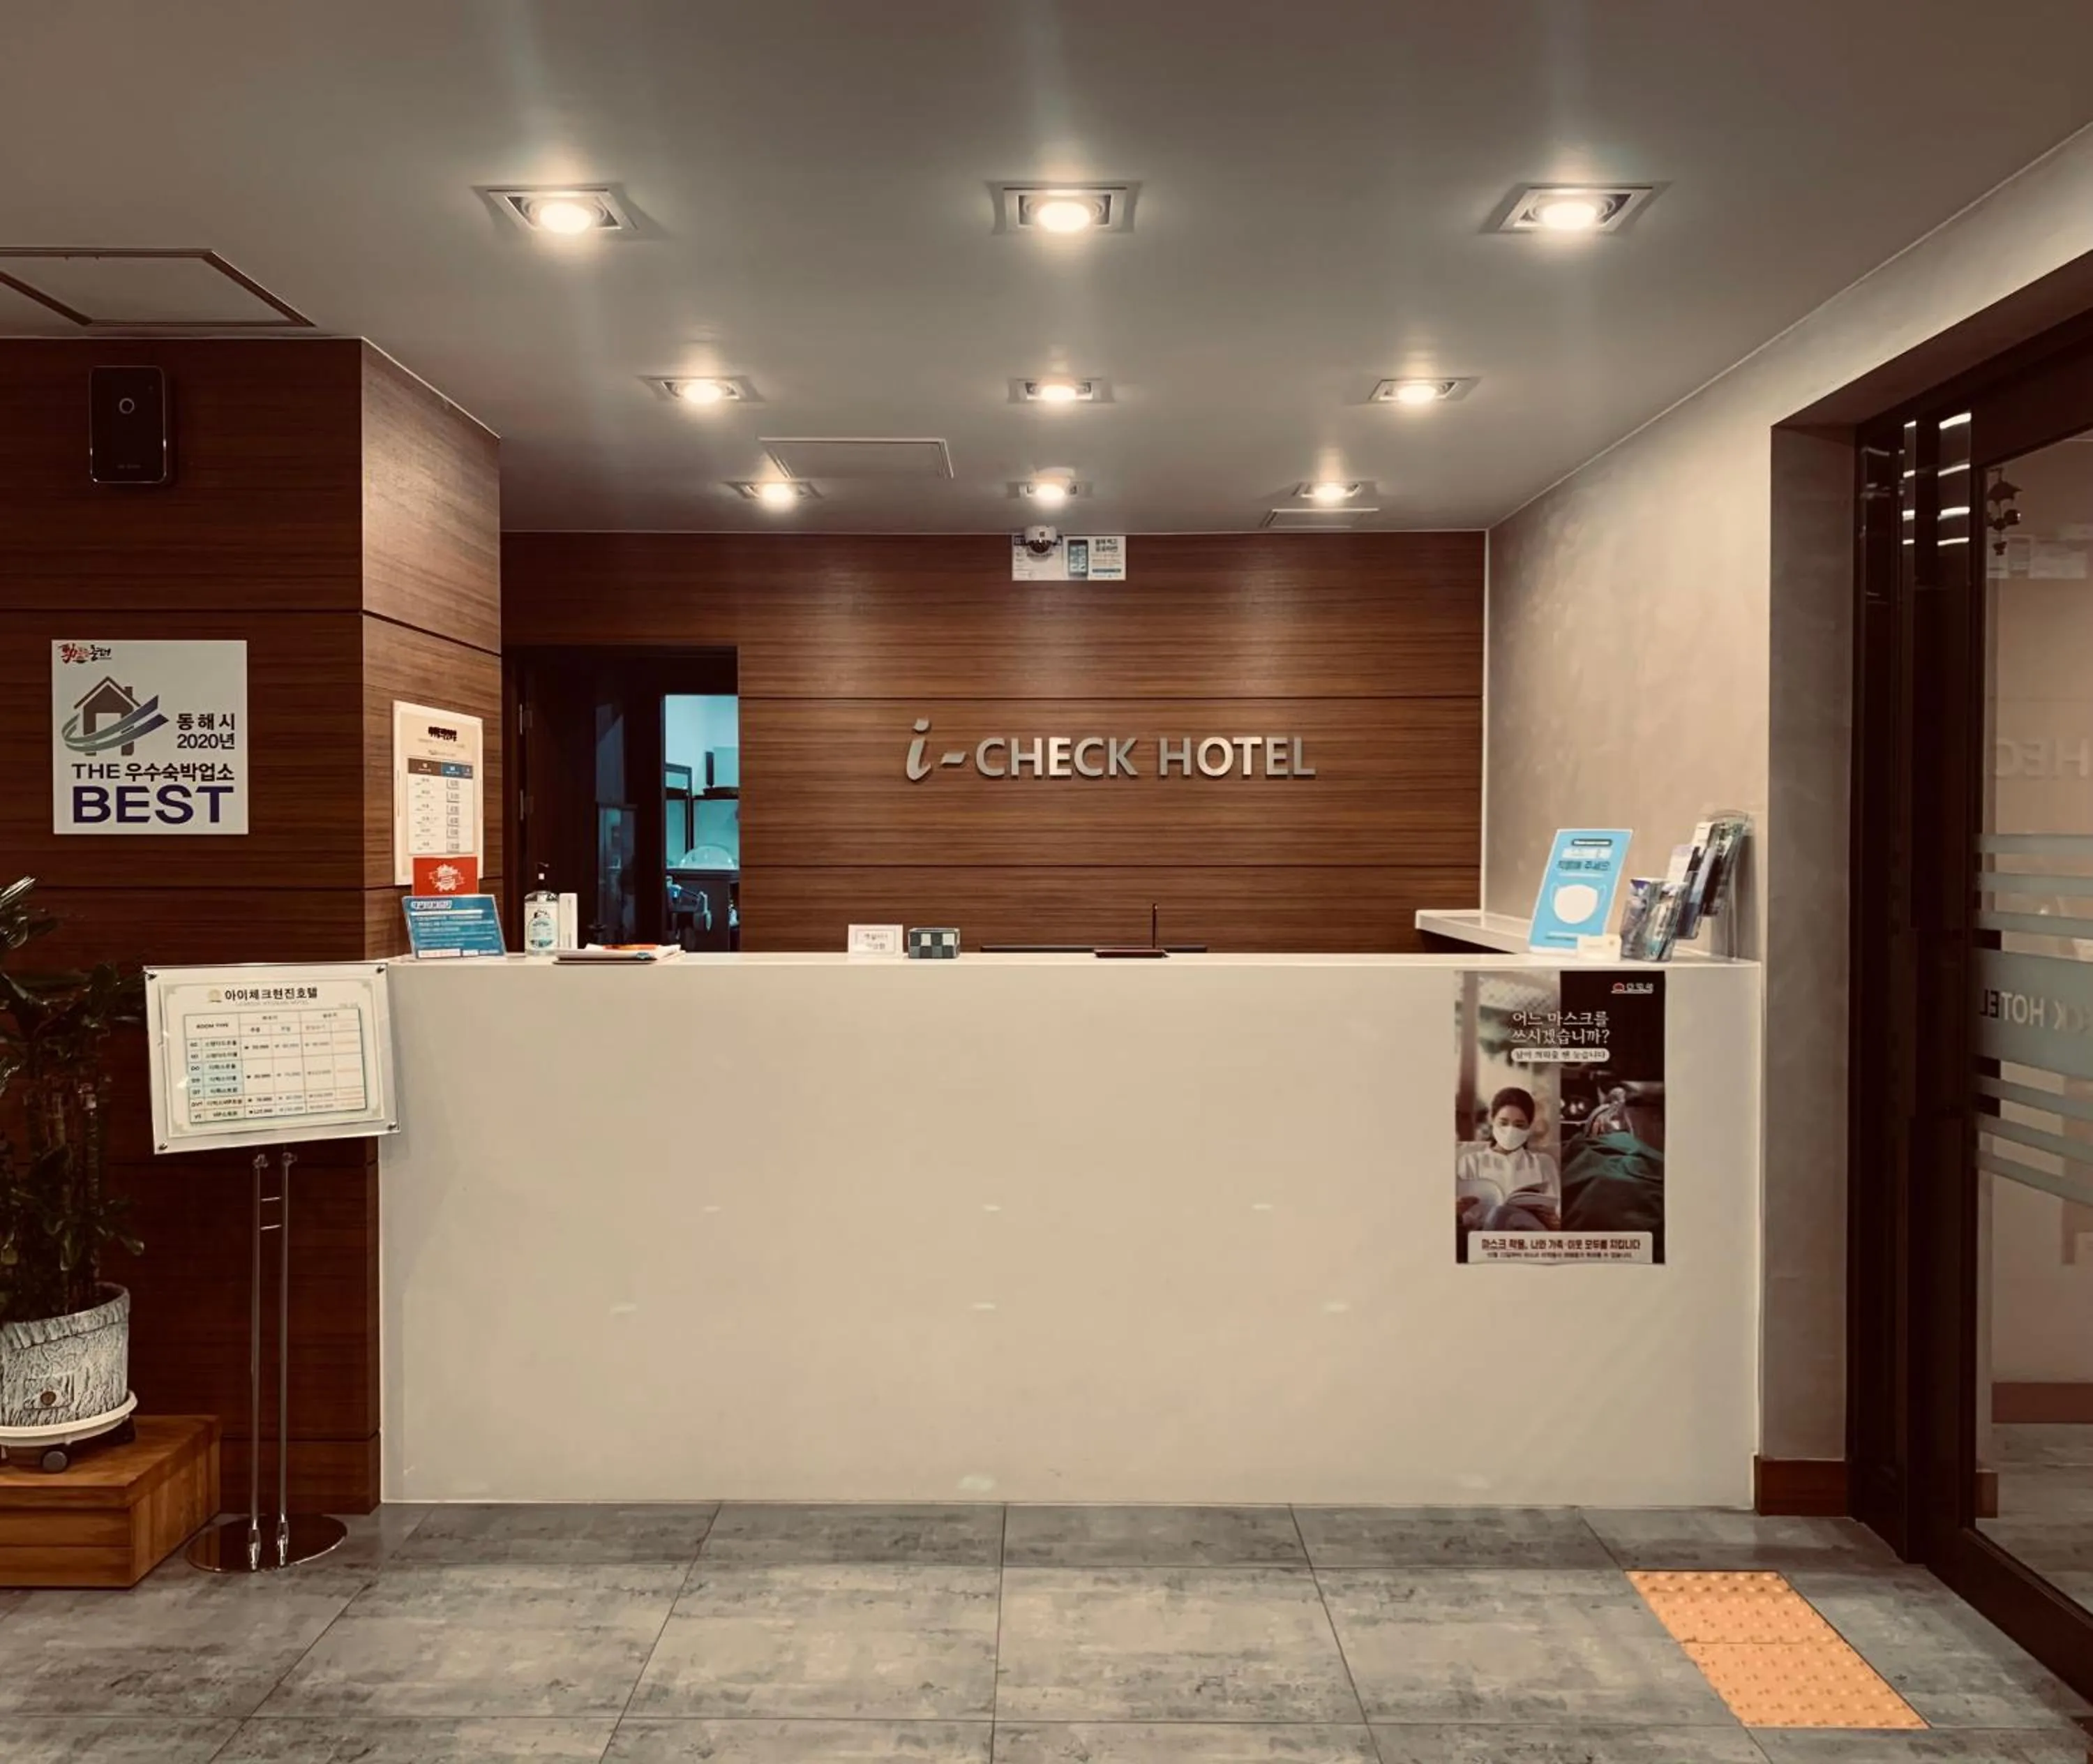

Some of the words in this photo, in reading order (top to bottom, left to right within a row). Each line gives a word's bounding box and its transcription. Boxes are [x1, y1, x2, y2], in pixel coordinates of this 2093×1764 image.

[177, 733, 235, 750] 2020년
[1159, 737, 1316, 777] HOTEL
[72, 763, 120, 779] THE
[125, 763, 235, 782] 우수숙박업소
[73, 784, 234, 825] BEST
[1513, 1011, 1543, 1026] 어느
[1547, 1010, 1610, 1027] 마스크를
[1510, 1027, 1610, 1045] 쓰시겠습니까?
